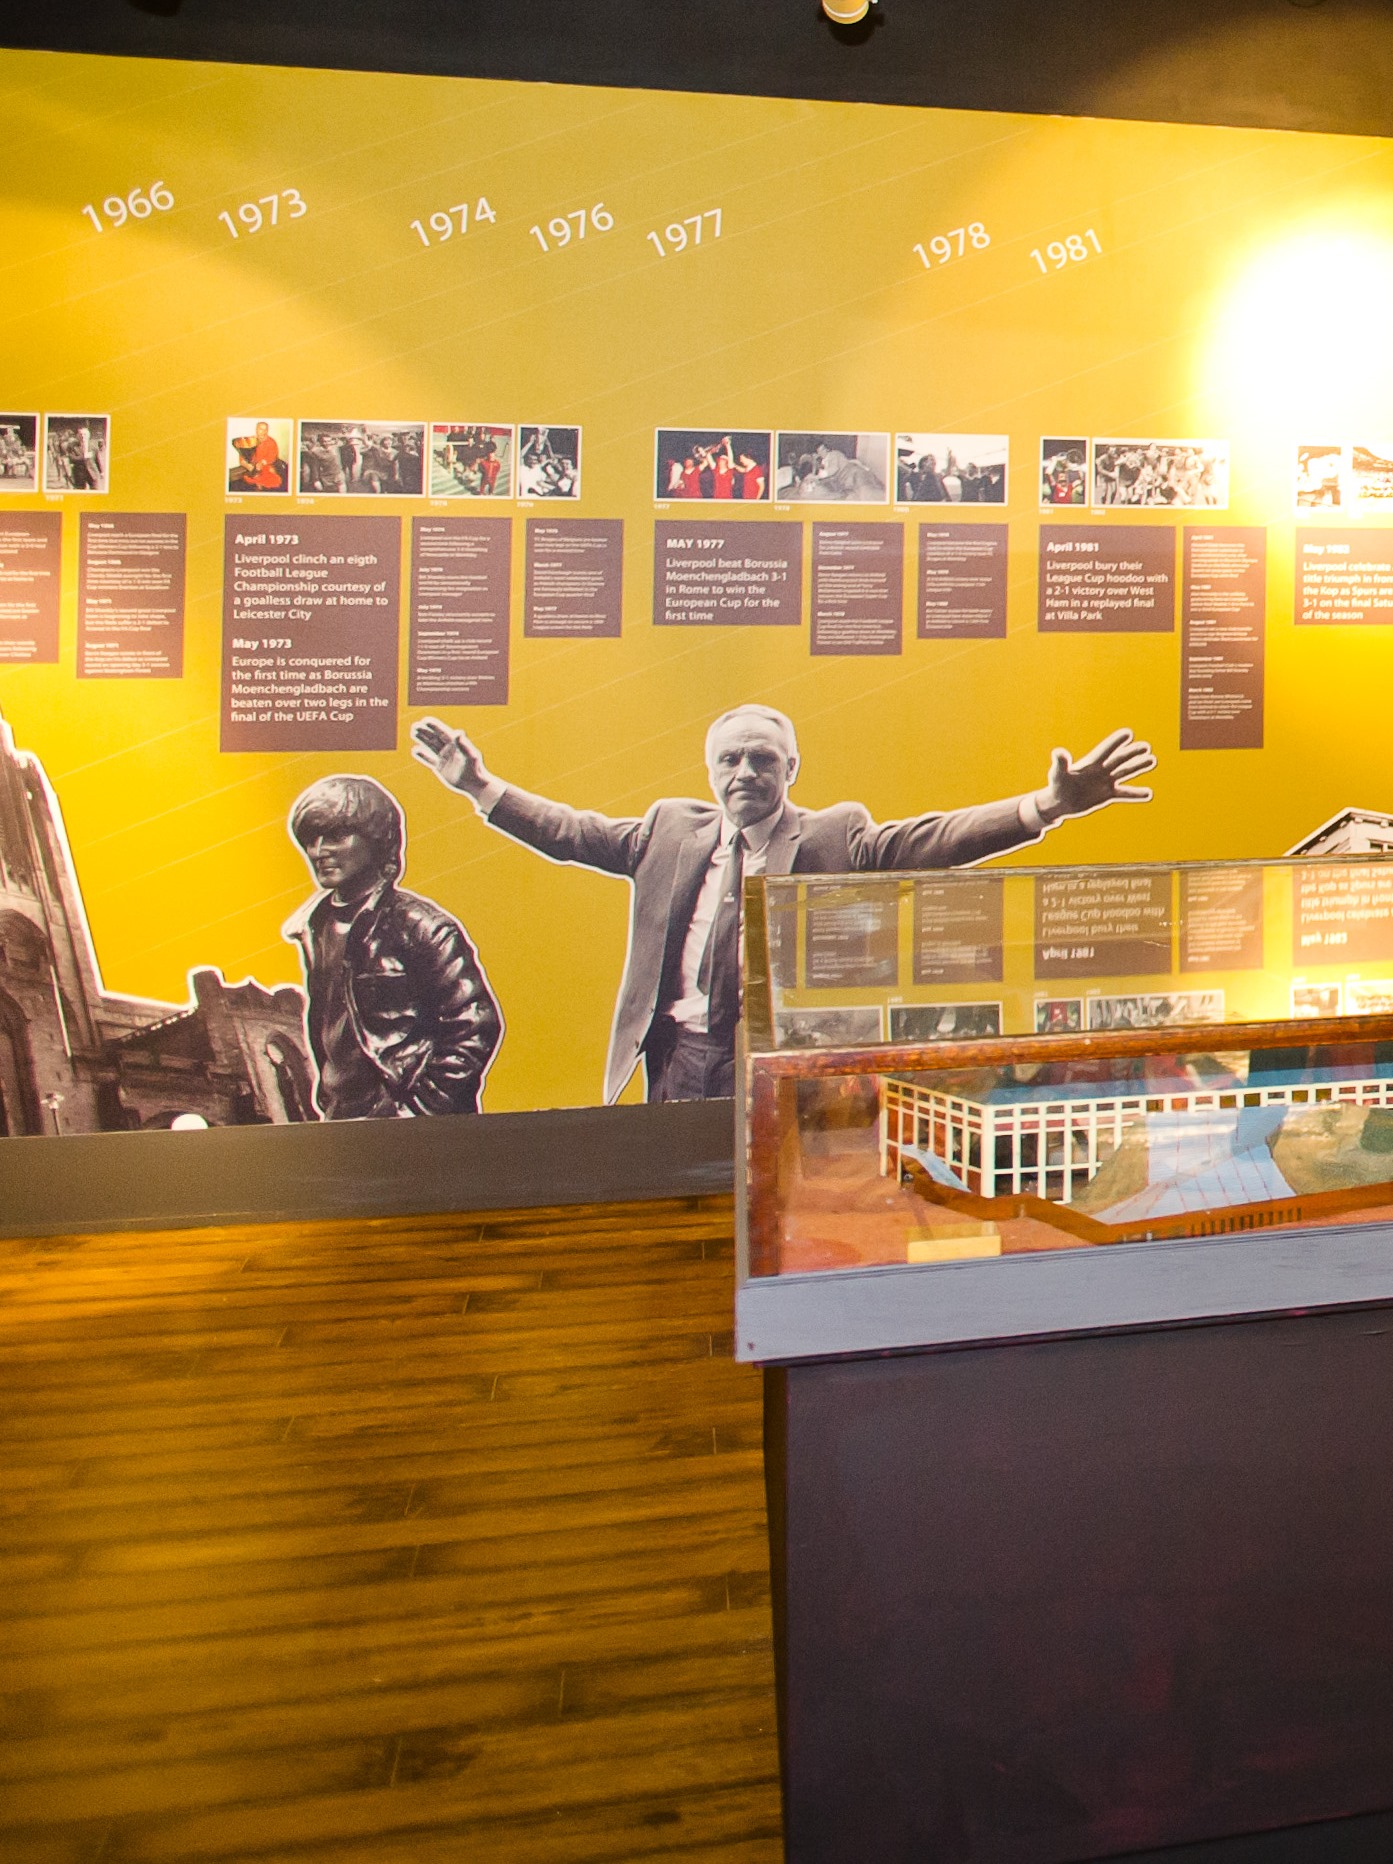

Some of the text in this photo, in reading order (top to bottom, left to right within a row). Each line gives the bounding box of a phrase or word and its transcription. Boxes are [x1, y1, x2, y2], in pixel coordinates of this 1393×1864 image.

[81, 180, 175, 234] 1966
[217, 188, 308, 240] 1973
[409, 196, 498, 248] 1974
[528, 202, 615, 253] 1976
[646, 208, 725, 258] 1977
[912, 220, 992, 270] 1978
[1029, 227, 1104, 277] 1981
[235, 534, 299, 546] April 1973
[666, 539, 725, 549] MAY 1977
[1046, 542, 1099, 553] April 1981
[235, 553, 377, 567] Liverpool clinch an eigth
[666, 558, 788, 570] Liverpool beat Borussia
[1047, 560, 1143, 572] Liverpool bury their
[234, 567, 328, 580] Football League
[234, 581, 386, 594] Championship courtesy of
[234, 595, 388, 607] a goalless draw at home to
[233, 609, 312, 621] Leicester City
[232, 638, 292, 651] May 1973
